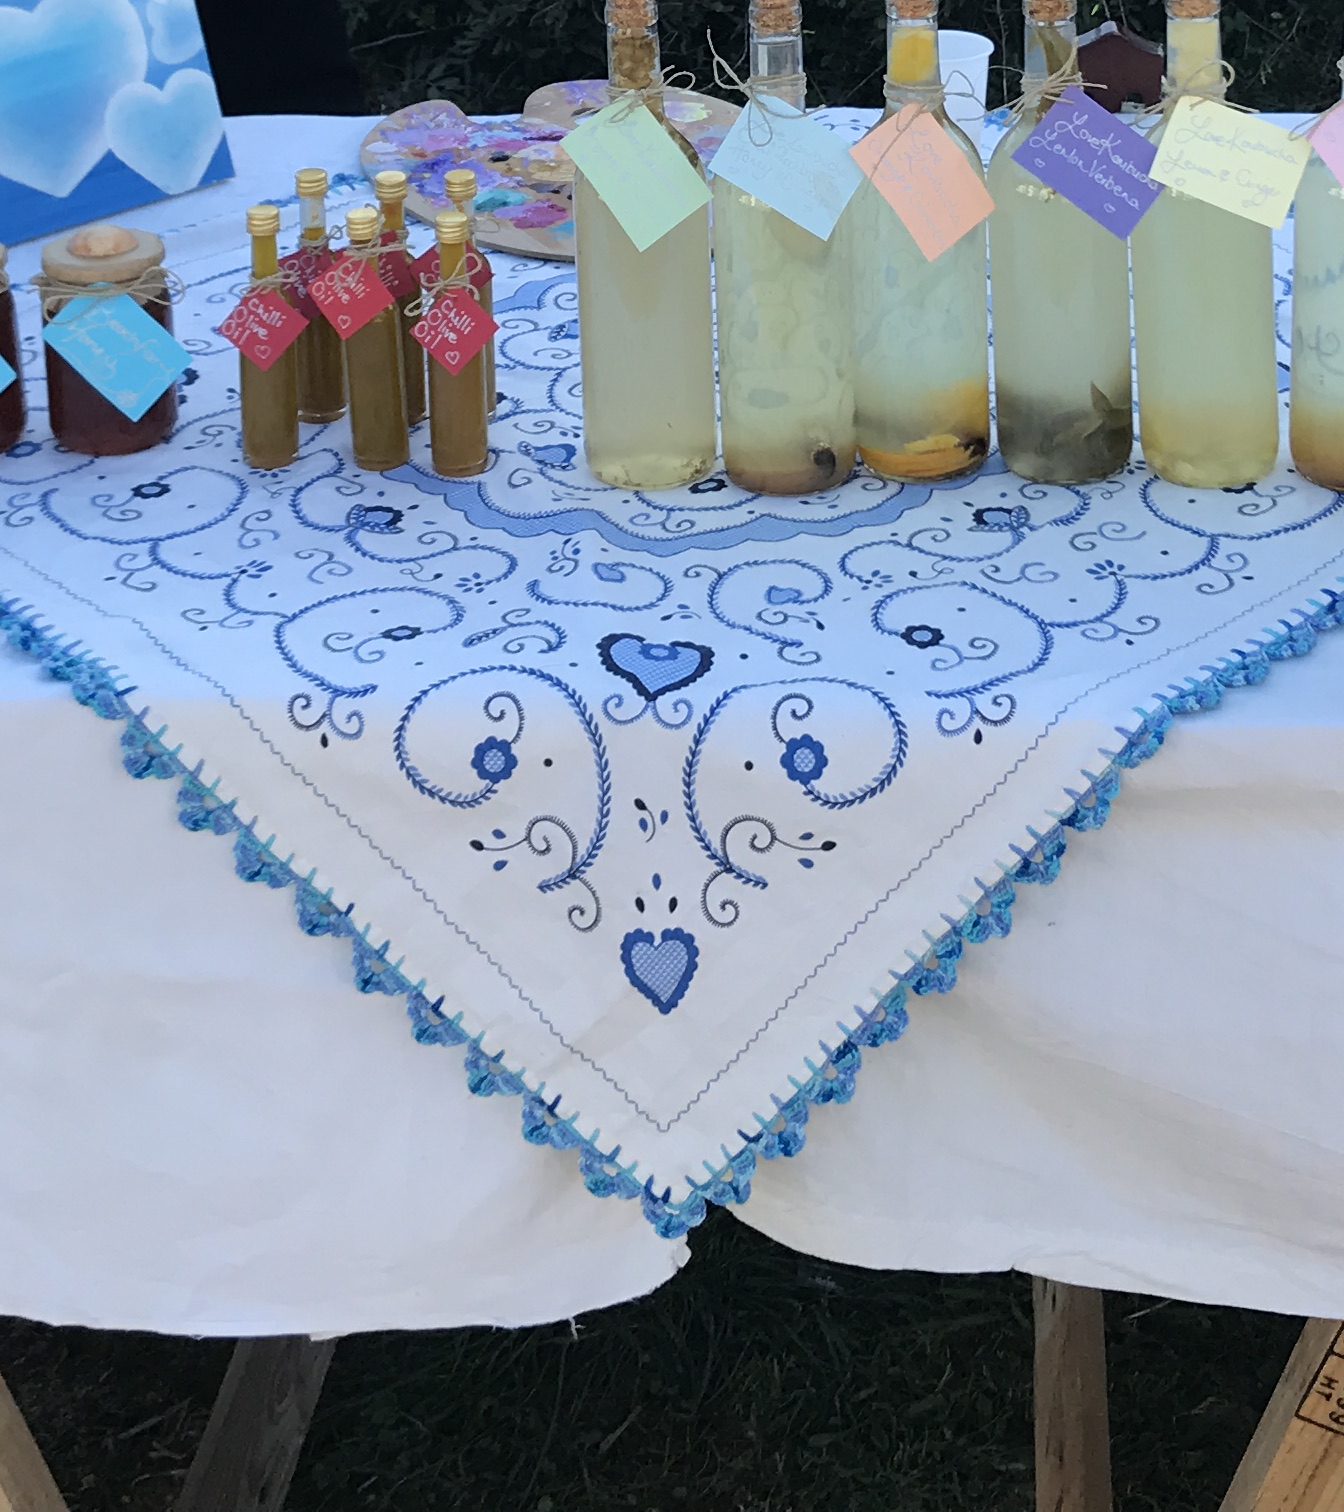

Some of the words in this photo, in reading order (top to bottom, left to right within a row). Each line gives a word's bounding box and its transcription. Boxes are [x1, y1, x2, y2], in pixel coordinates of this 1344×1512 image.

[311, 281, 335, 305] Oil
[233, 306, 270, 340] Olive
[248, 298, 287, 328] Chilli
[427, 308, 458, 344] Olive
[441, 299, 476, 335] Chilli
[221, 319, 252, 345] Oil
[414, 321, 442, 349] Oil
[1316, 1375, 1340, 1402] HT
